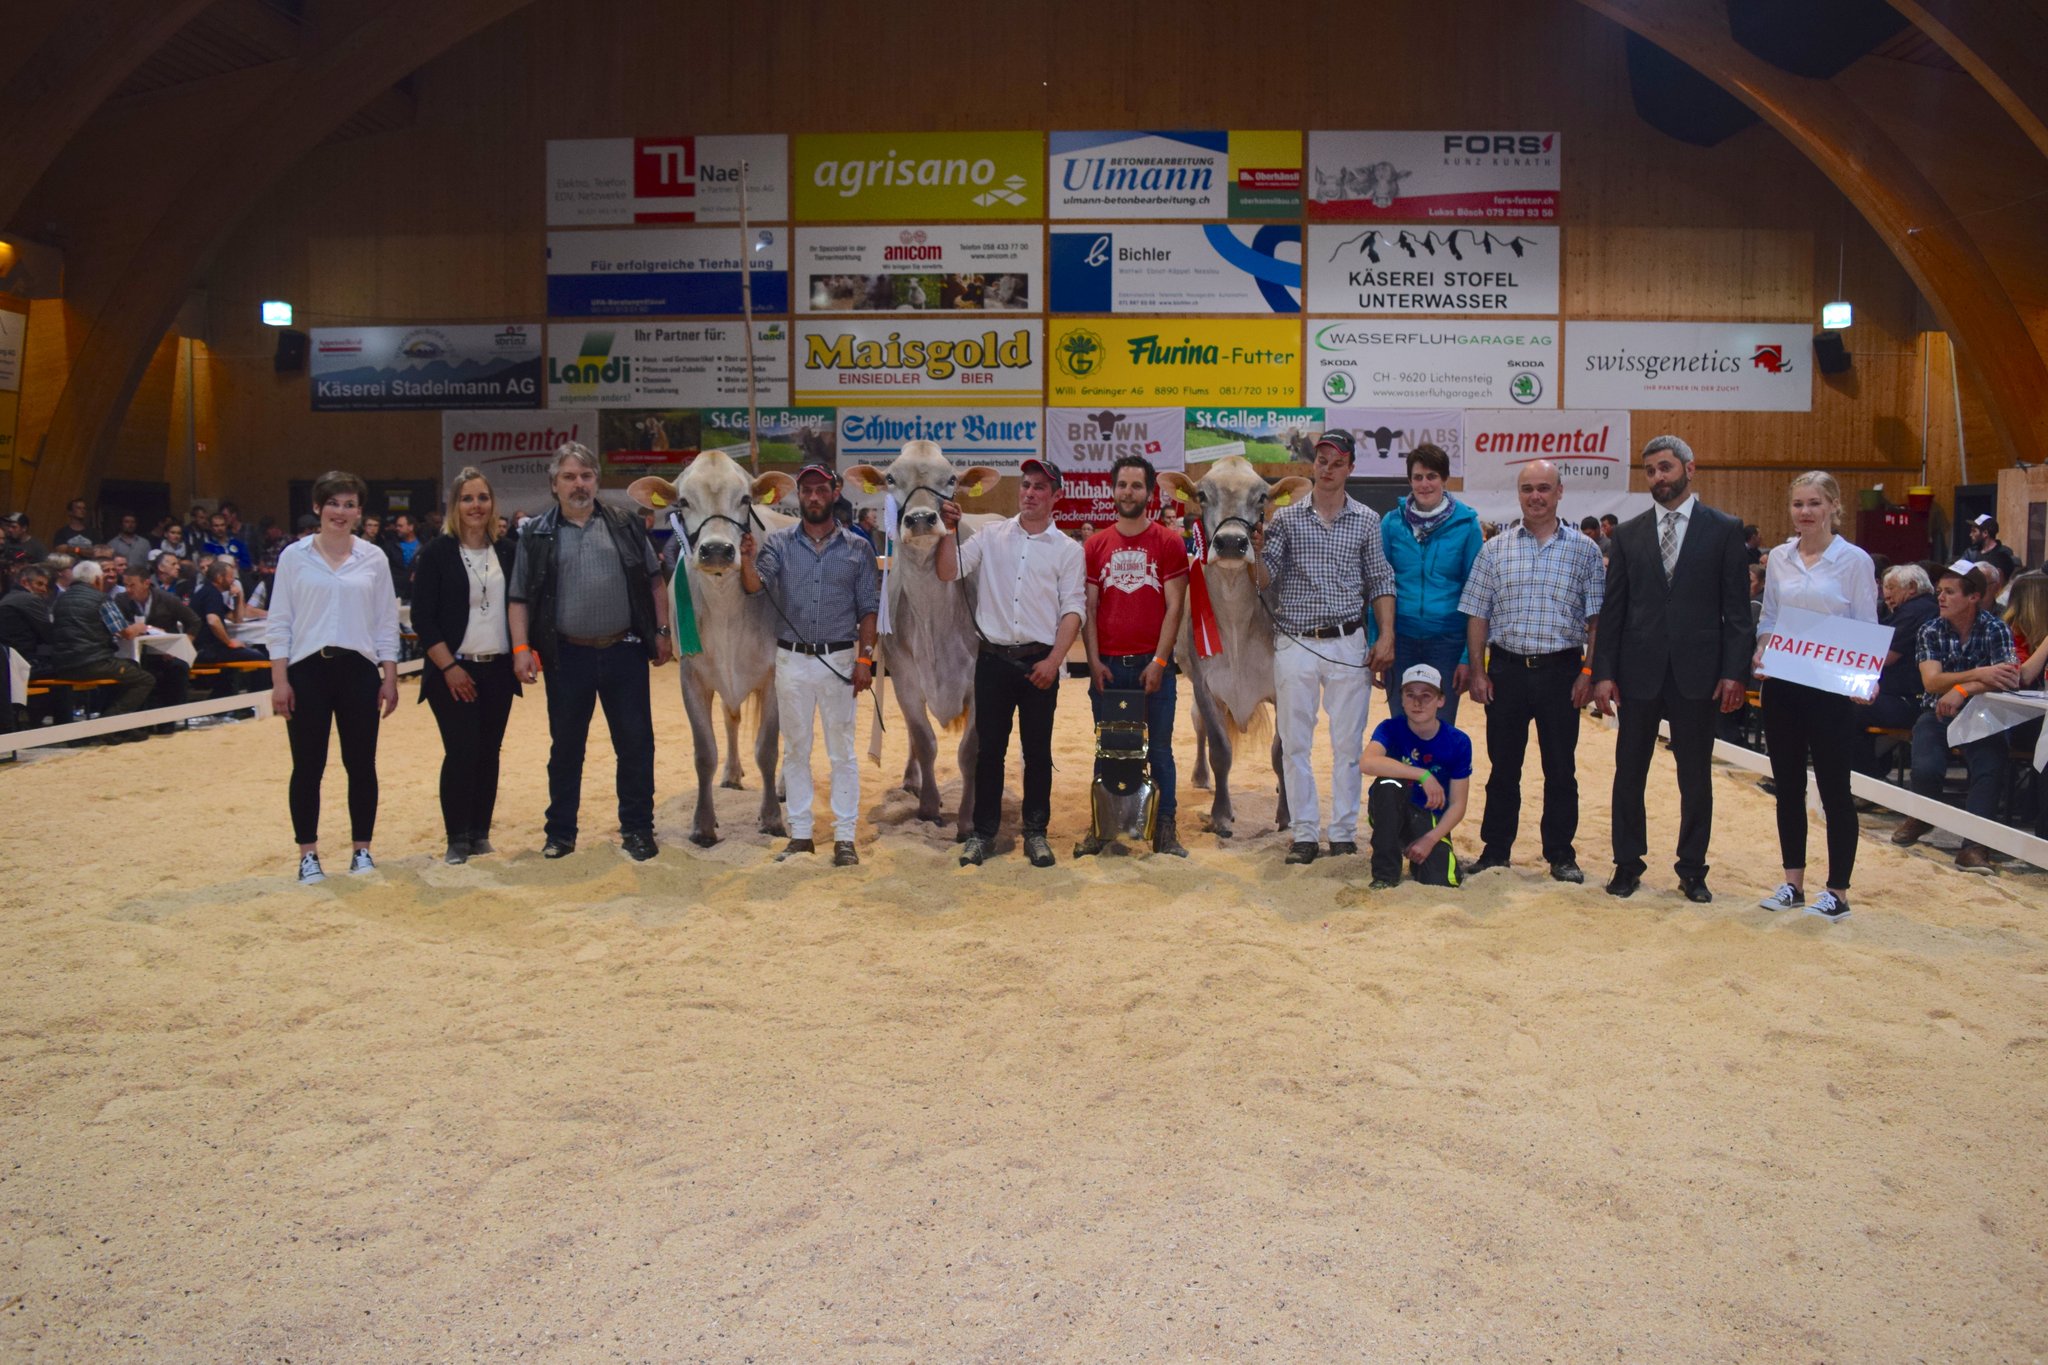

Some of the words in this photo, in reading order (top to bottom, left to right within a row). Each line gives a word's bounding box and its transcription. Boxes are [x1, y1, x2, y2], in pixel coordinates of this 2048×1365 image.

[1444, 135, 1542, 155] FORS
[1110, 157, 1215, 167] BETONBEARBEITUNG
[1444, 157, 1481, 166] KUNZ
[1493, 158, 1551, 167] KUNATH
[814, 149, 996, 197] agrisano
[1063, 158, 1214, 192] Ulmann
[1063, 194, 1211, 206] ulmann-betonbearbeitung.ch
[1493, 196, 1554, 206] fors-futter.ch
[1428, 208, 1455, 217] Lukas
[1457, 208, 1484, 217] Bösch
[884, 244, 943, 260] anicom
[1118, 247, 1172, 262] Bichler
[591, 261, 612, 271] Für
[616, 258, 695, 273] erfolgreiche
[699, 256, 774, 270] Tierhalung
[1349, 268, 1434, 288] KÄSEREI
[1443, 272, 1519, 288] STOFEL
[1358, 293, 1508, 309] UNTERWASSER
[634, 328, 652, 342] Ihr
[655, 328, 701, 342] Partner
[704, 327, 726, 341] für:
[1530, 335, 1552, 347] AG
[804, 329, 1032, 380] Maisgold
[1127, 333, 1220, 366] Flurina
[548, 355, 630, 385] Landi
[1320, 358, 1358, 368] ŠKODA
[1506, 359, 1545, 369] ŠKODA
[1585, 347, 1742, 381] swissgenetics
[839, 373, 921, 385] EINSIEDLER
[961, 372, 993, 384] BIER
[1372, 372, 1391, 383] CH
[1399, 372, 1427, 383] 9620
[1430, 372, 1493, 386] Lichtensteig
[318, 379, 386, 398] Käserei
[391, 378, 500, 396] Stadelmann
[505, 377, 535, 395] AG
[1055, 386, 1076, 396] Willi
[1081, 385, 1128, 397] Grüninger
[1130, 387, 1144, 396] AG
[1154, 386, 1180, 396] 8890
[1183, 386, 1210, 395] Flums
[1219, 386, 1262, 396] 081/720
[1267, 386, 1278, 395] 19
[1282, 386, 1293, 395] 19
[1372, 387, 1493, 399] www.wasserfluhgarage.ch
[710, 410, 776, 430] St.Galer
[780, 410, 825, 427] Bauer
[1195, 410, 1265, 429] St.Galler
[1267, 410, 1313, 428] Bauer
[961, 414, 1038, 443] Bauer
[1435, 428, 1458, 443] BS
[452, 423, 579, 452] emmental
[1474, 425, 1609, 453] emmental
[1072, 443, 1145, 461] SWISS
[955, 459, 966, 467] die
[967, 459, 1019, 468] Landwirtschaft
[1768, 633, 1884, 673] RAIFFEISEN
